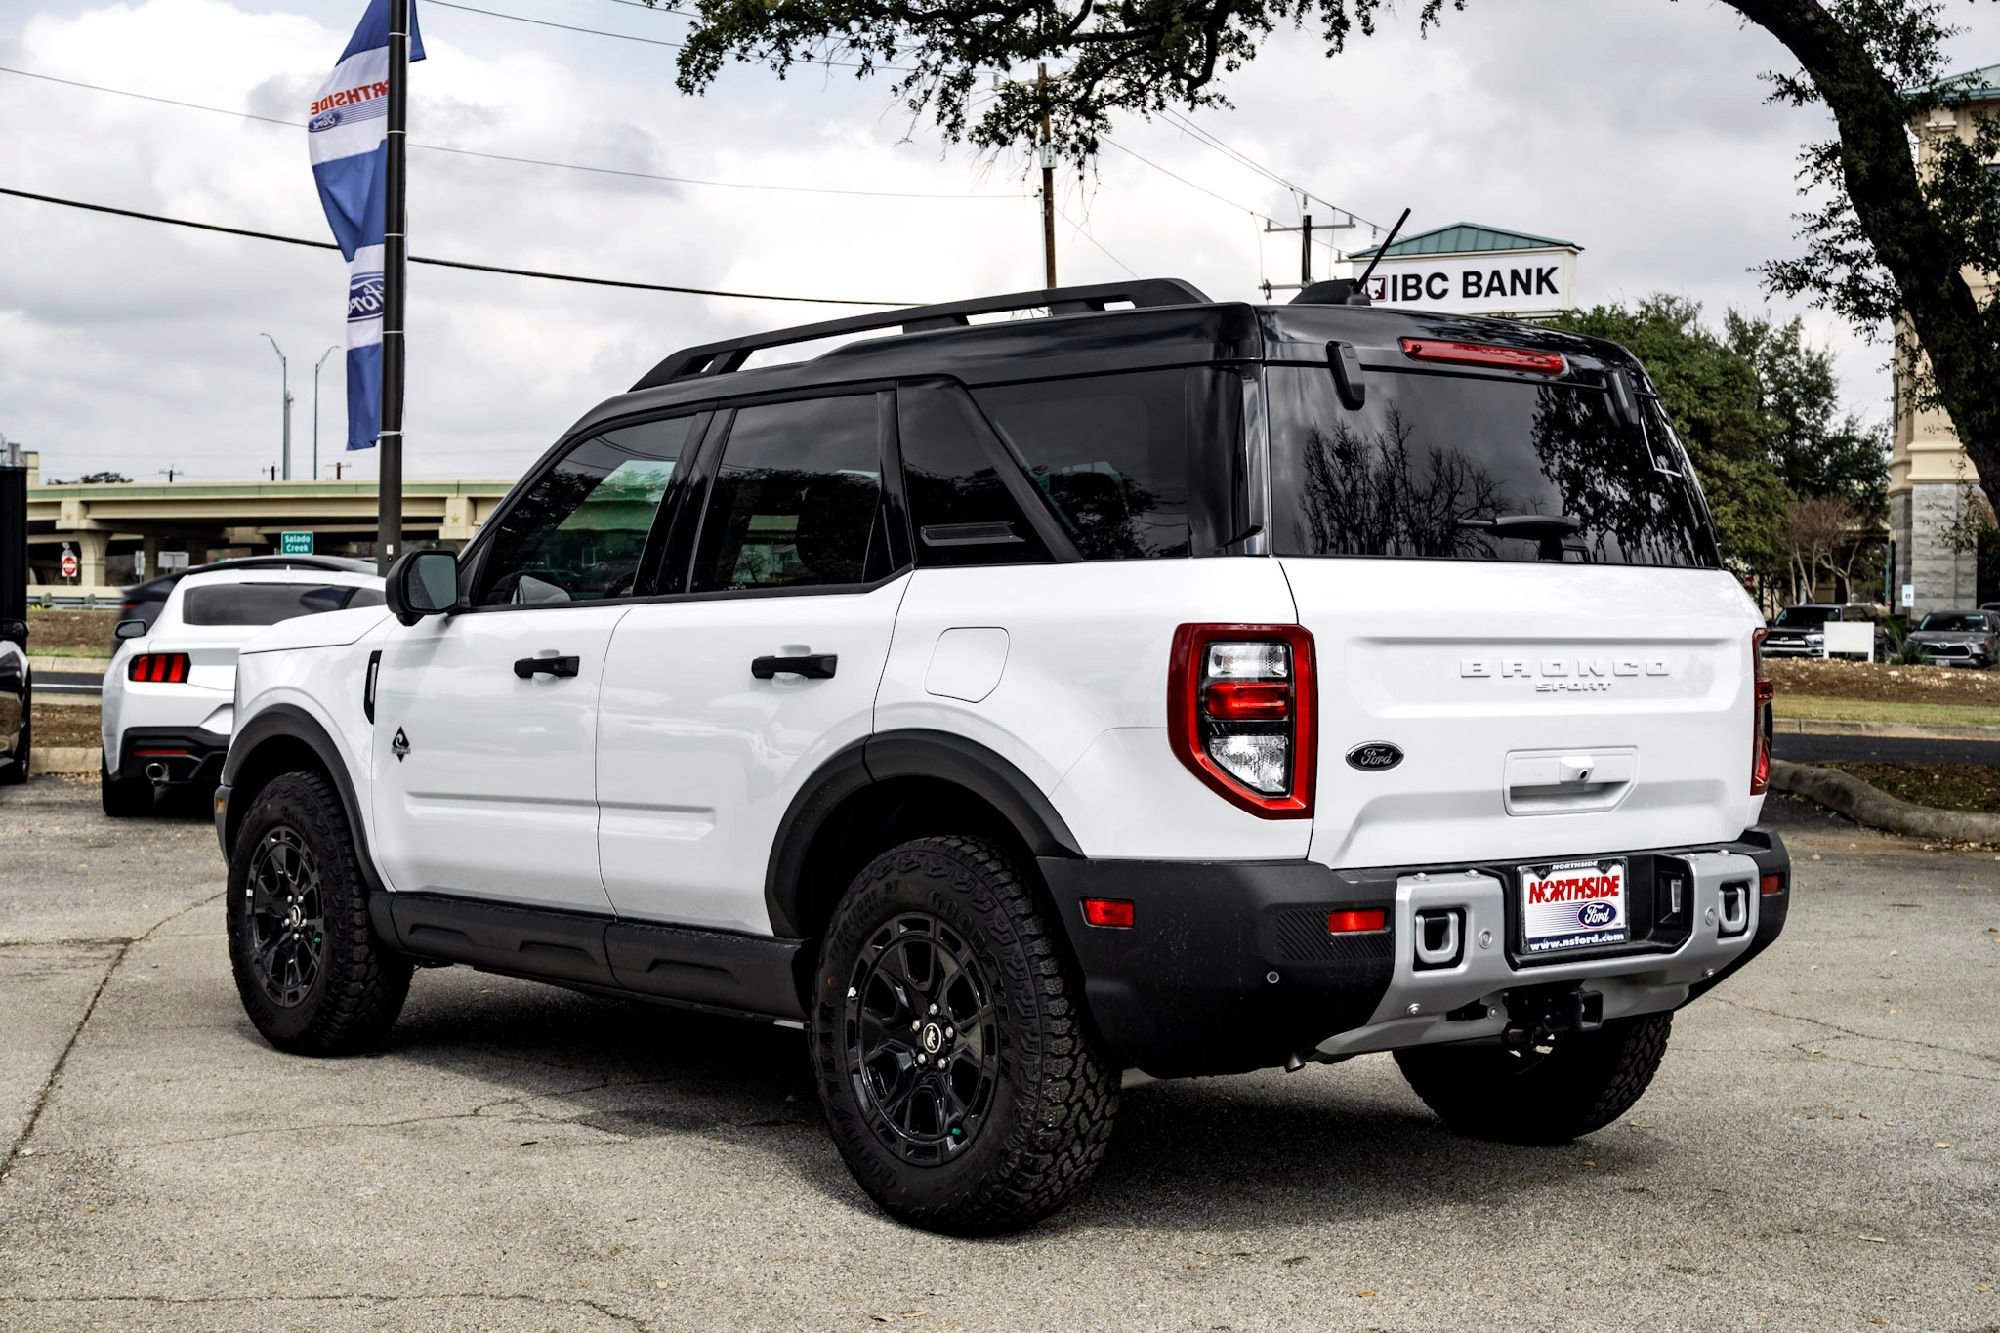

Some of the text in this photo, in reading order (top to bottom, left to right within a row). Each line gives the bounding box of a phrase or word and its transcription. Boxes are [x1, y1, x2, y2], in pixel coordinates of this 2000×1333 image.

[1391, 267, 1559, 302] IBC BANK
[284, 534, 311, 543] Salado
[286, 544, 309, 552] Creek
[1459, 657, 1671, 678] BRONCO
[1535, 682, 1608, 692] SPORT
[1360, 747, 1394, 766] Ford
[1552, 860, 1599, 870] NORTHSIDE
[1528, 875, 1620, 904] NORTHSIDE
[1584, 903, 1610, 923] Ford
[1530, 933, 1624, 951] www.nsford.com
